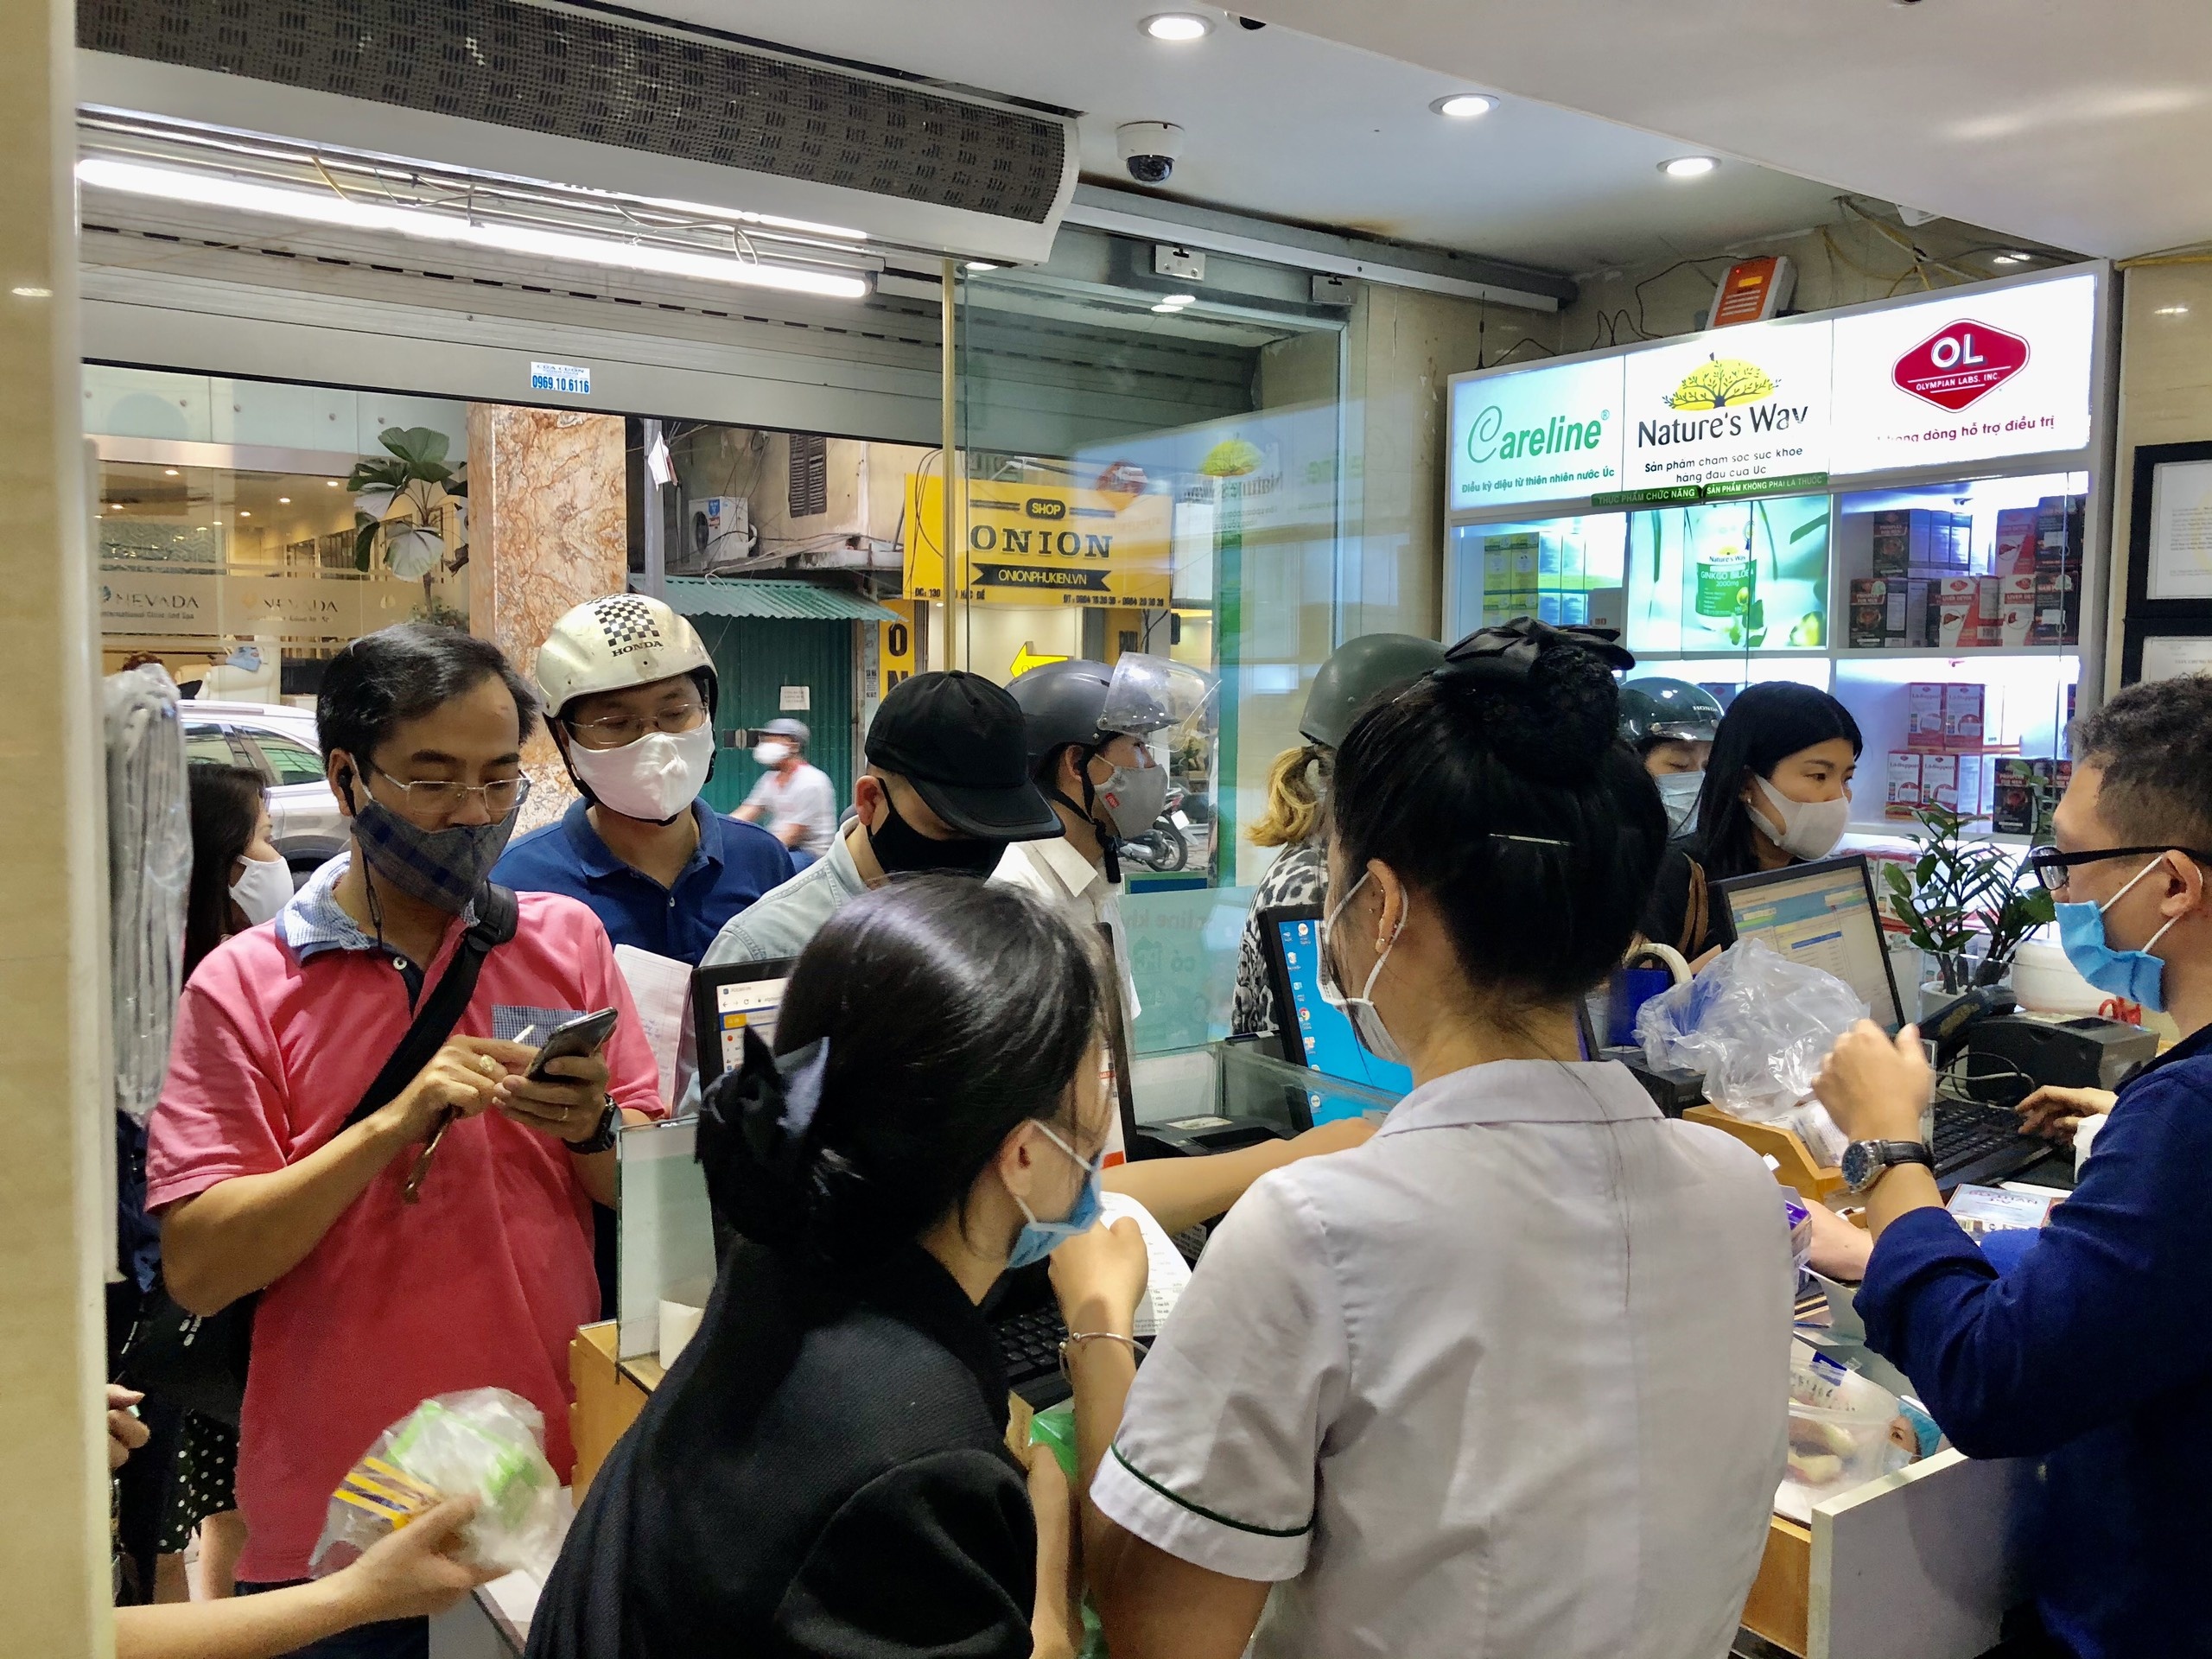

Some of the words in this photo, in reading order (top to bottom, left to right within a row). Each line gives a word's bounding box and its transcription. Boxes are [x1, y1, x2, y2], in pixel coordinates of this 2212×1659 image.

[1931, 334, 1985, 369] OL
[532, 375, 589, 393] 0969.10.6116
[1916, 378, 1955, 391] OLYMPIAN
[1467, 405, 1602, 463] Careline
[1638, 412, 1742, 448] Nature's
[1923, 426, 1956, 441] dòng
[2040, 415, 2055, 429] trị
[1550, 470, 1574, 483] nhiên
[1603, 466, 1615, 477] Úc
[1031, 502, 1061, 516] SHOP
[969, 524, 1114, 559] ONION
[998, 569, 1088, 586] ONIONPHUKIEN.VN
[612, 640, 664, 657] HONDA
